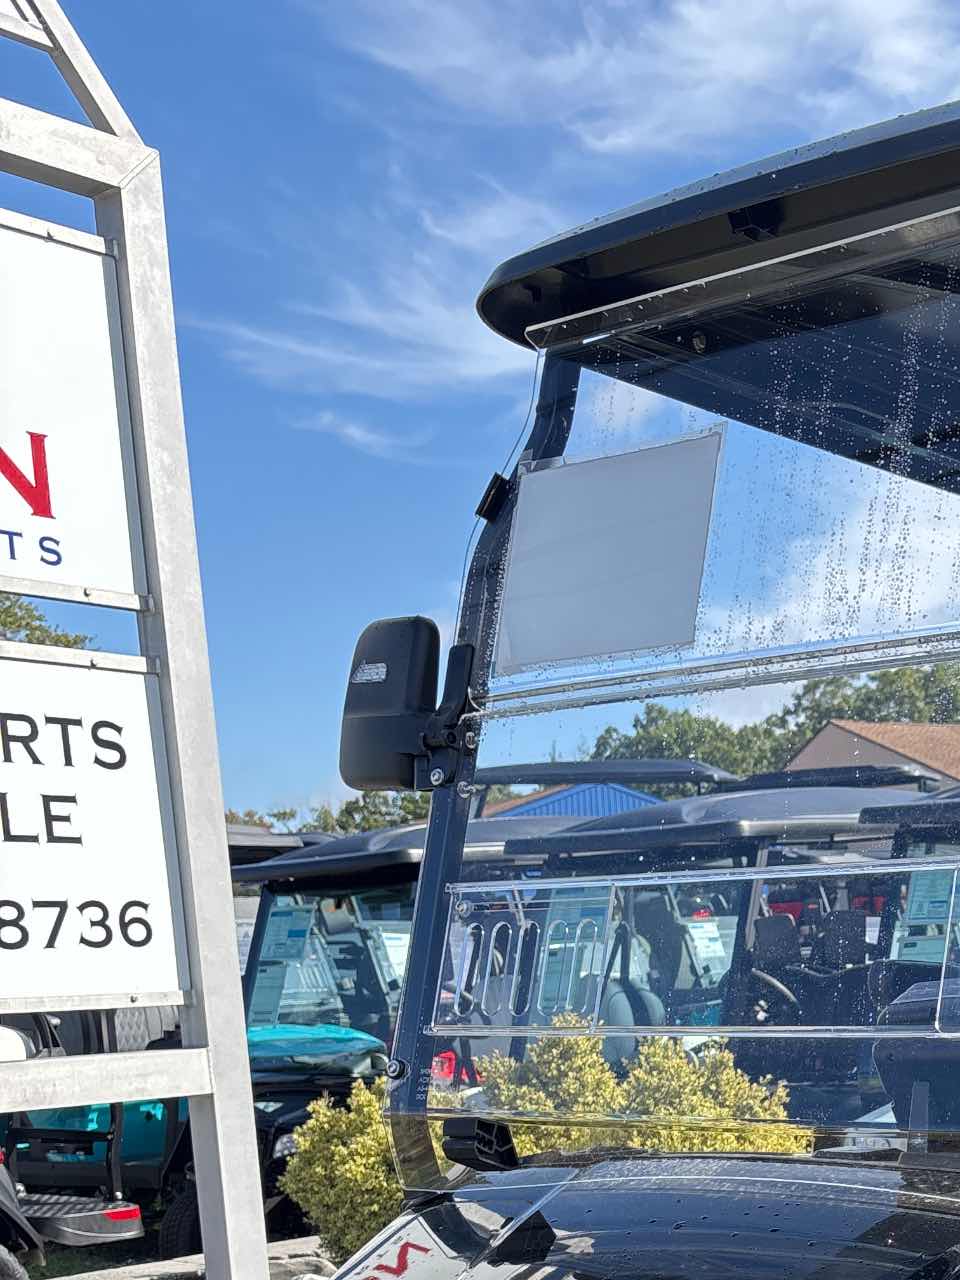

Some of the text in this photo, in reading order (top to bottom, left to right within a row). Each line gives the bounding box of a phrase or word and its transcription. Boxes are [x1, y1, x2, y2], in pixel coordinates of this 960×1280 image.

[0, 712, 127, 770] RTS
[0, 792, 83, 846] LE
[0, 899, 152, 950] 8736
